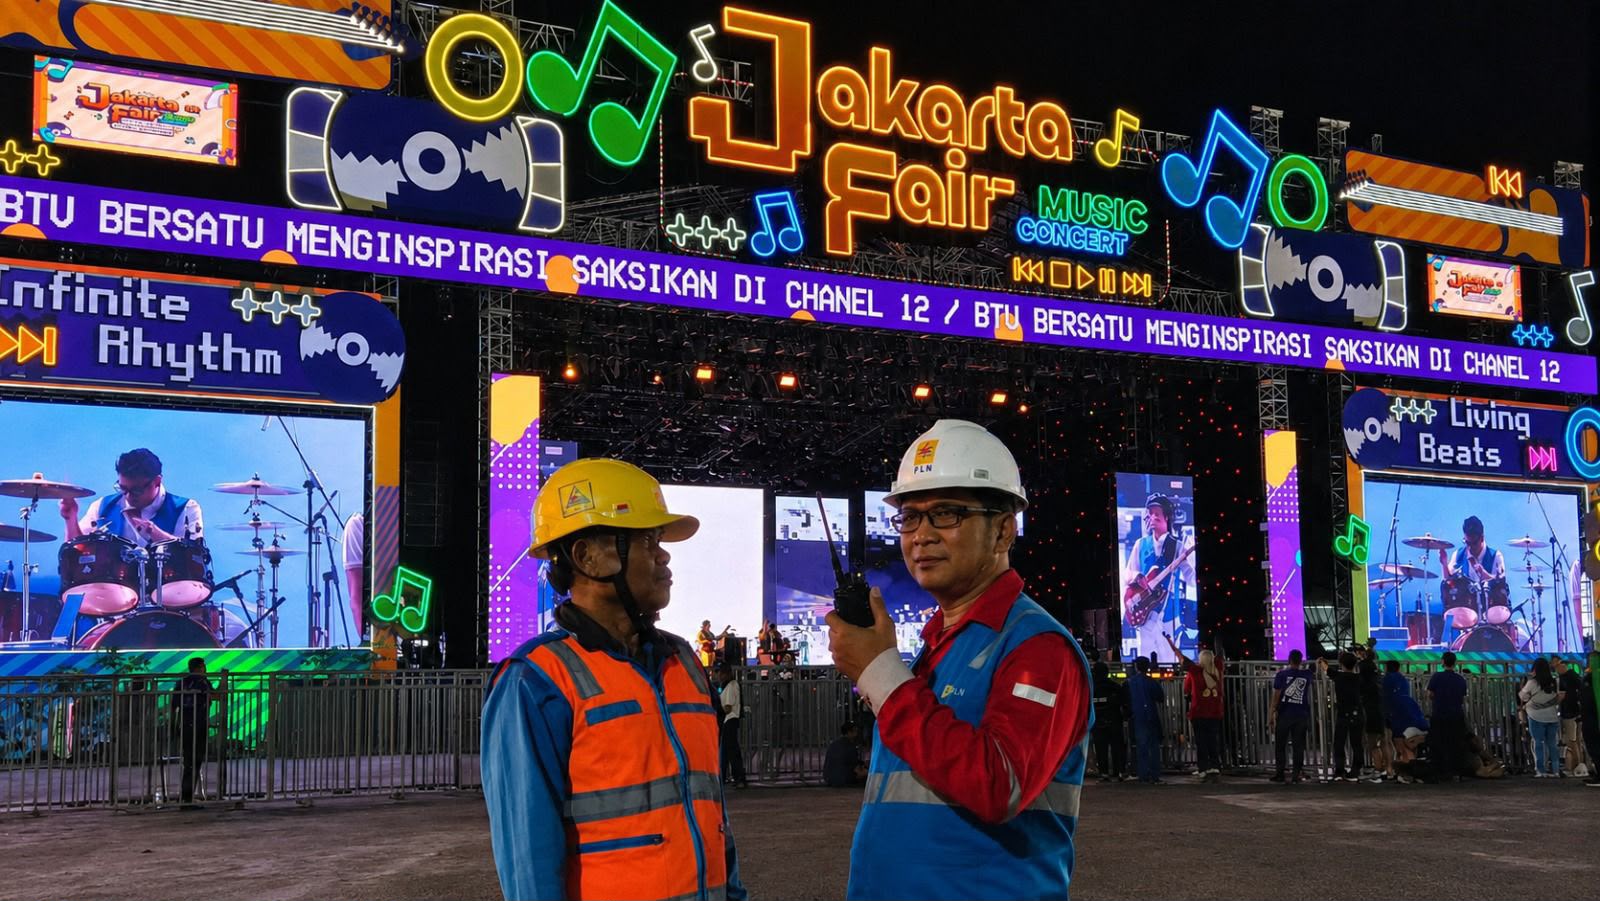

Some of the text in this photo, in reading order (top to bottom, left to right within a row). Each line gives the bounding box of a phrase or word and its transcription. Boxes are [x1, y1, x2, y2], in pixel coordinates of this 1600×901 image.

[689, 5, 1075, 172] Jakarta
[824, 142, 1016, 256] Fair
[1038, 184, 1149, 234] MUSIC
[1016, 216, 1129, 256] CONCERT
[0, 187, 75, 228] BTU
[99, 199, 263, 250] BERSATU
[286, 221, 551, 280] MENGINSPIRASI
[571, 254, 717, 301] SAKSIKAN
[734, 273, 766, 305] DI
[785, 280, 884, 319] CHANEL
[901, 293, 930, 324] 12
[974, 301, 1021, 331] BTU
[1033, 307, 1134, 342] BERSATU
[1146, 318, 1312, 359] MENGINSPIRASI
[1324, 336, 1420, 370] SAKSIKAN
[1429, 348, 1452, 373] DI
[1463, 351, 1530, 381] CHANEL
[1539, 359, 1561, 383] 12
[99, 323, 282, 382] Rhythm
[1450, 397, 1530, 440] Living
[913, 464, 933, 475] PLN
[1419, 432, 1502, 467] Beats
